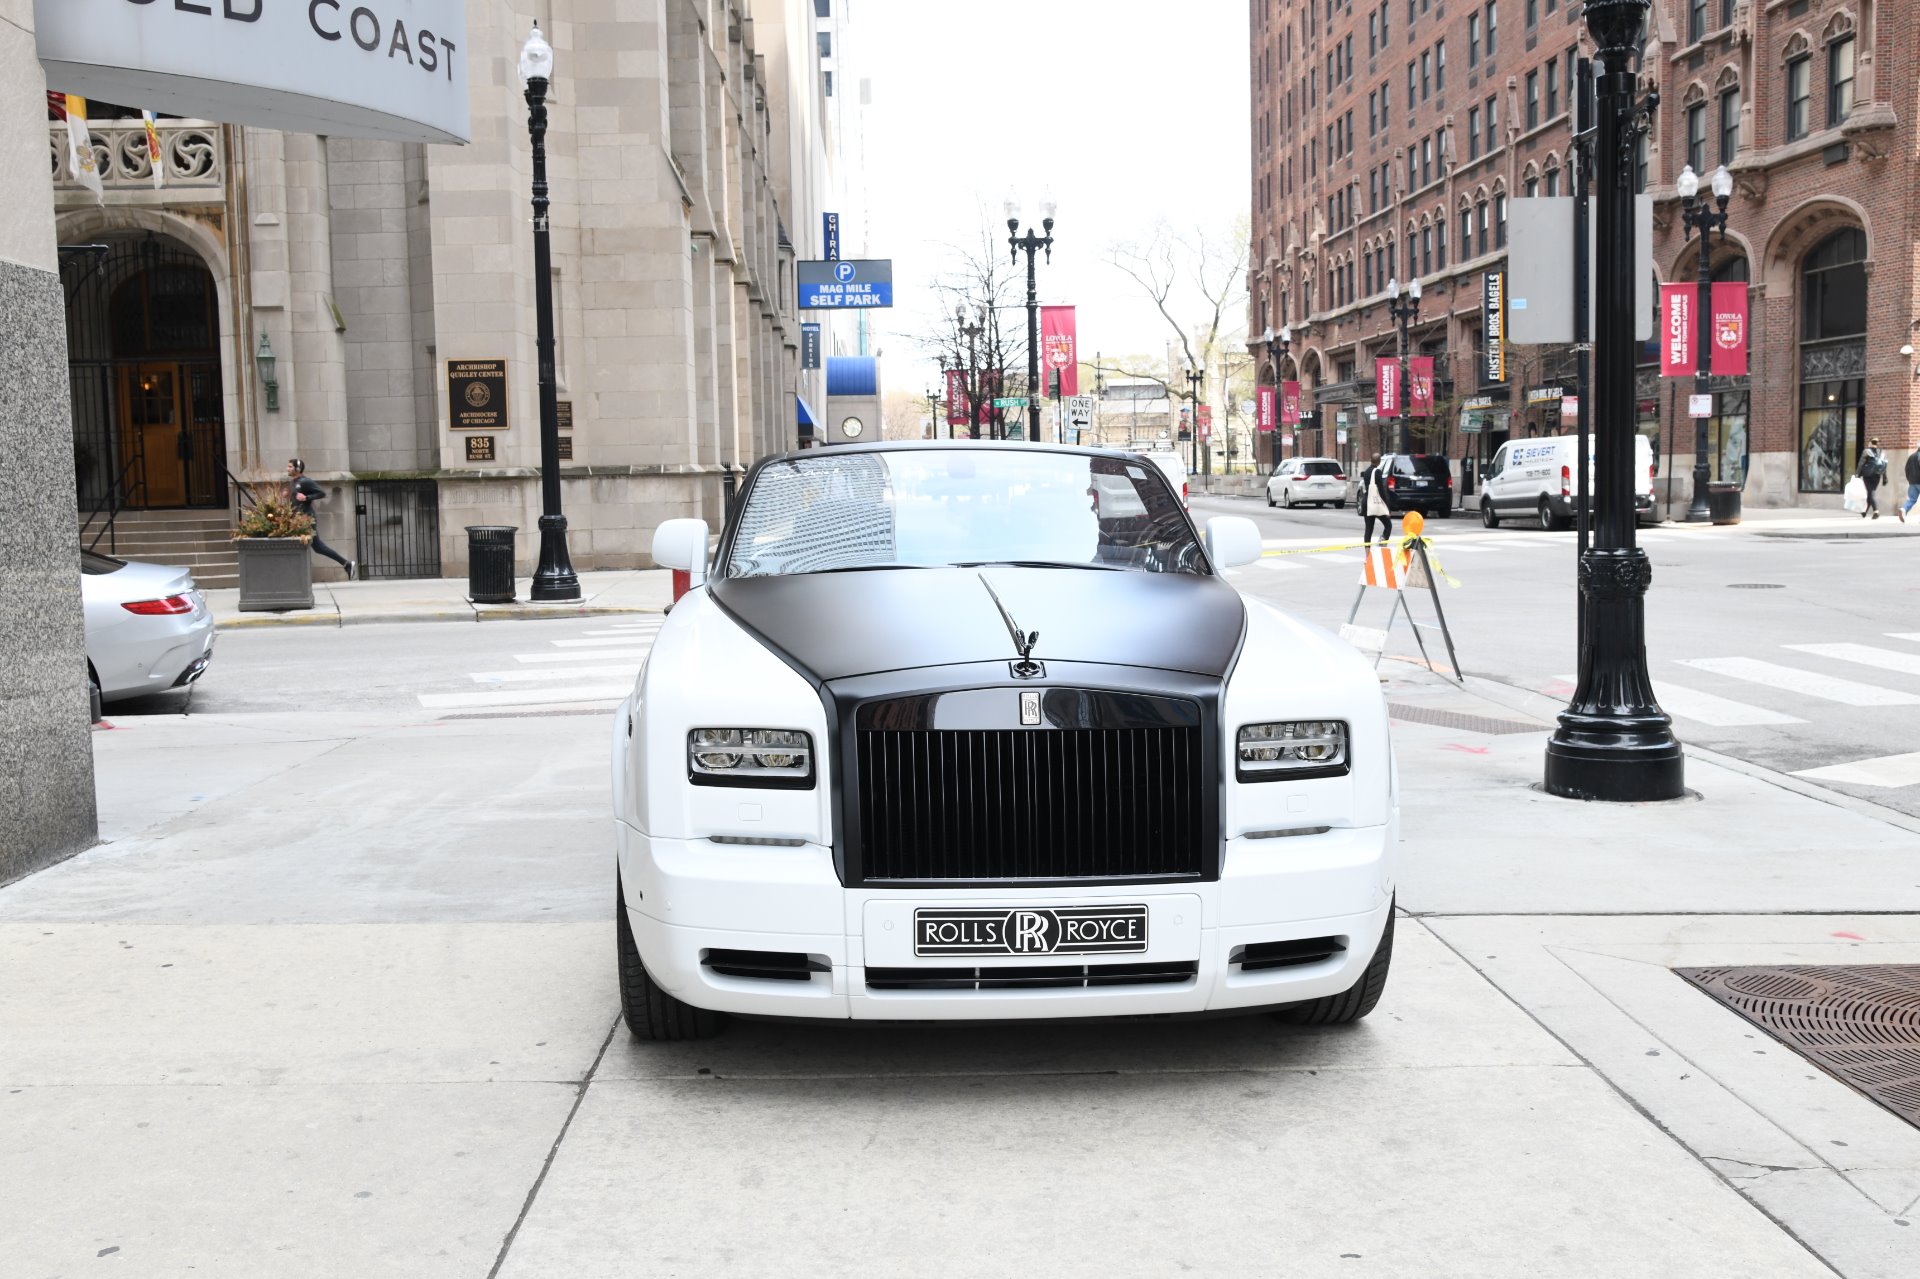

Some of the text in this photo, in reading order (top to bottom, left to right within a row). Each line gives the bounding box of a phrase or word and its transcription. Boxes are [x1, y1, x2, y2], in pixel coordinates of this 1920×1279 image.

[308, 0, 456, 81] COAST
[839, 264, 852, 280] P
[819, 283, 872, 294] MAG MILE
[810, 294, 881, 306] SELF PARK
[1489, 273, 1500, 380] EINSTEIN BROS. BAGELS
[1670, 294, 1682, 365] WELCOME
[456, 363, 497, 371] ARCHBISHOP
[450, 371, 478, 379] QUIGLEY
[1382, 364, 1390, 410] WELCOME
[1001, 399, 1019, 407] RUSH
[1071, 399, 1090, 408] ONE
[1261, 391, 1269, 426] WELCOME
[1070, 408, 1090, 417] WAY
[470, 437, 490, 448] 835
[926, 922, 997, 943] ROLLS
[1067, 919, 1137, 940] ROYCE
